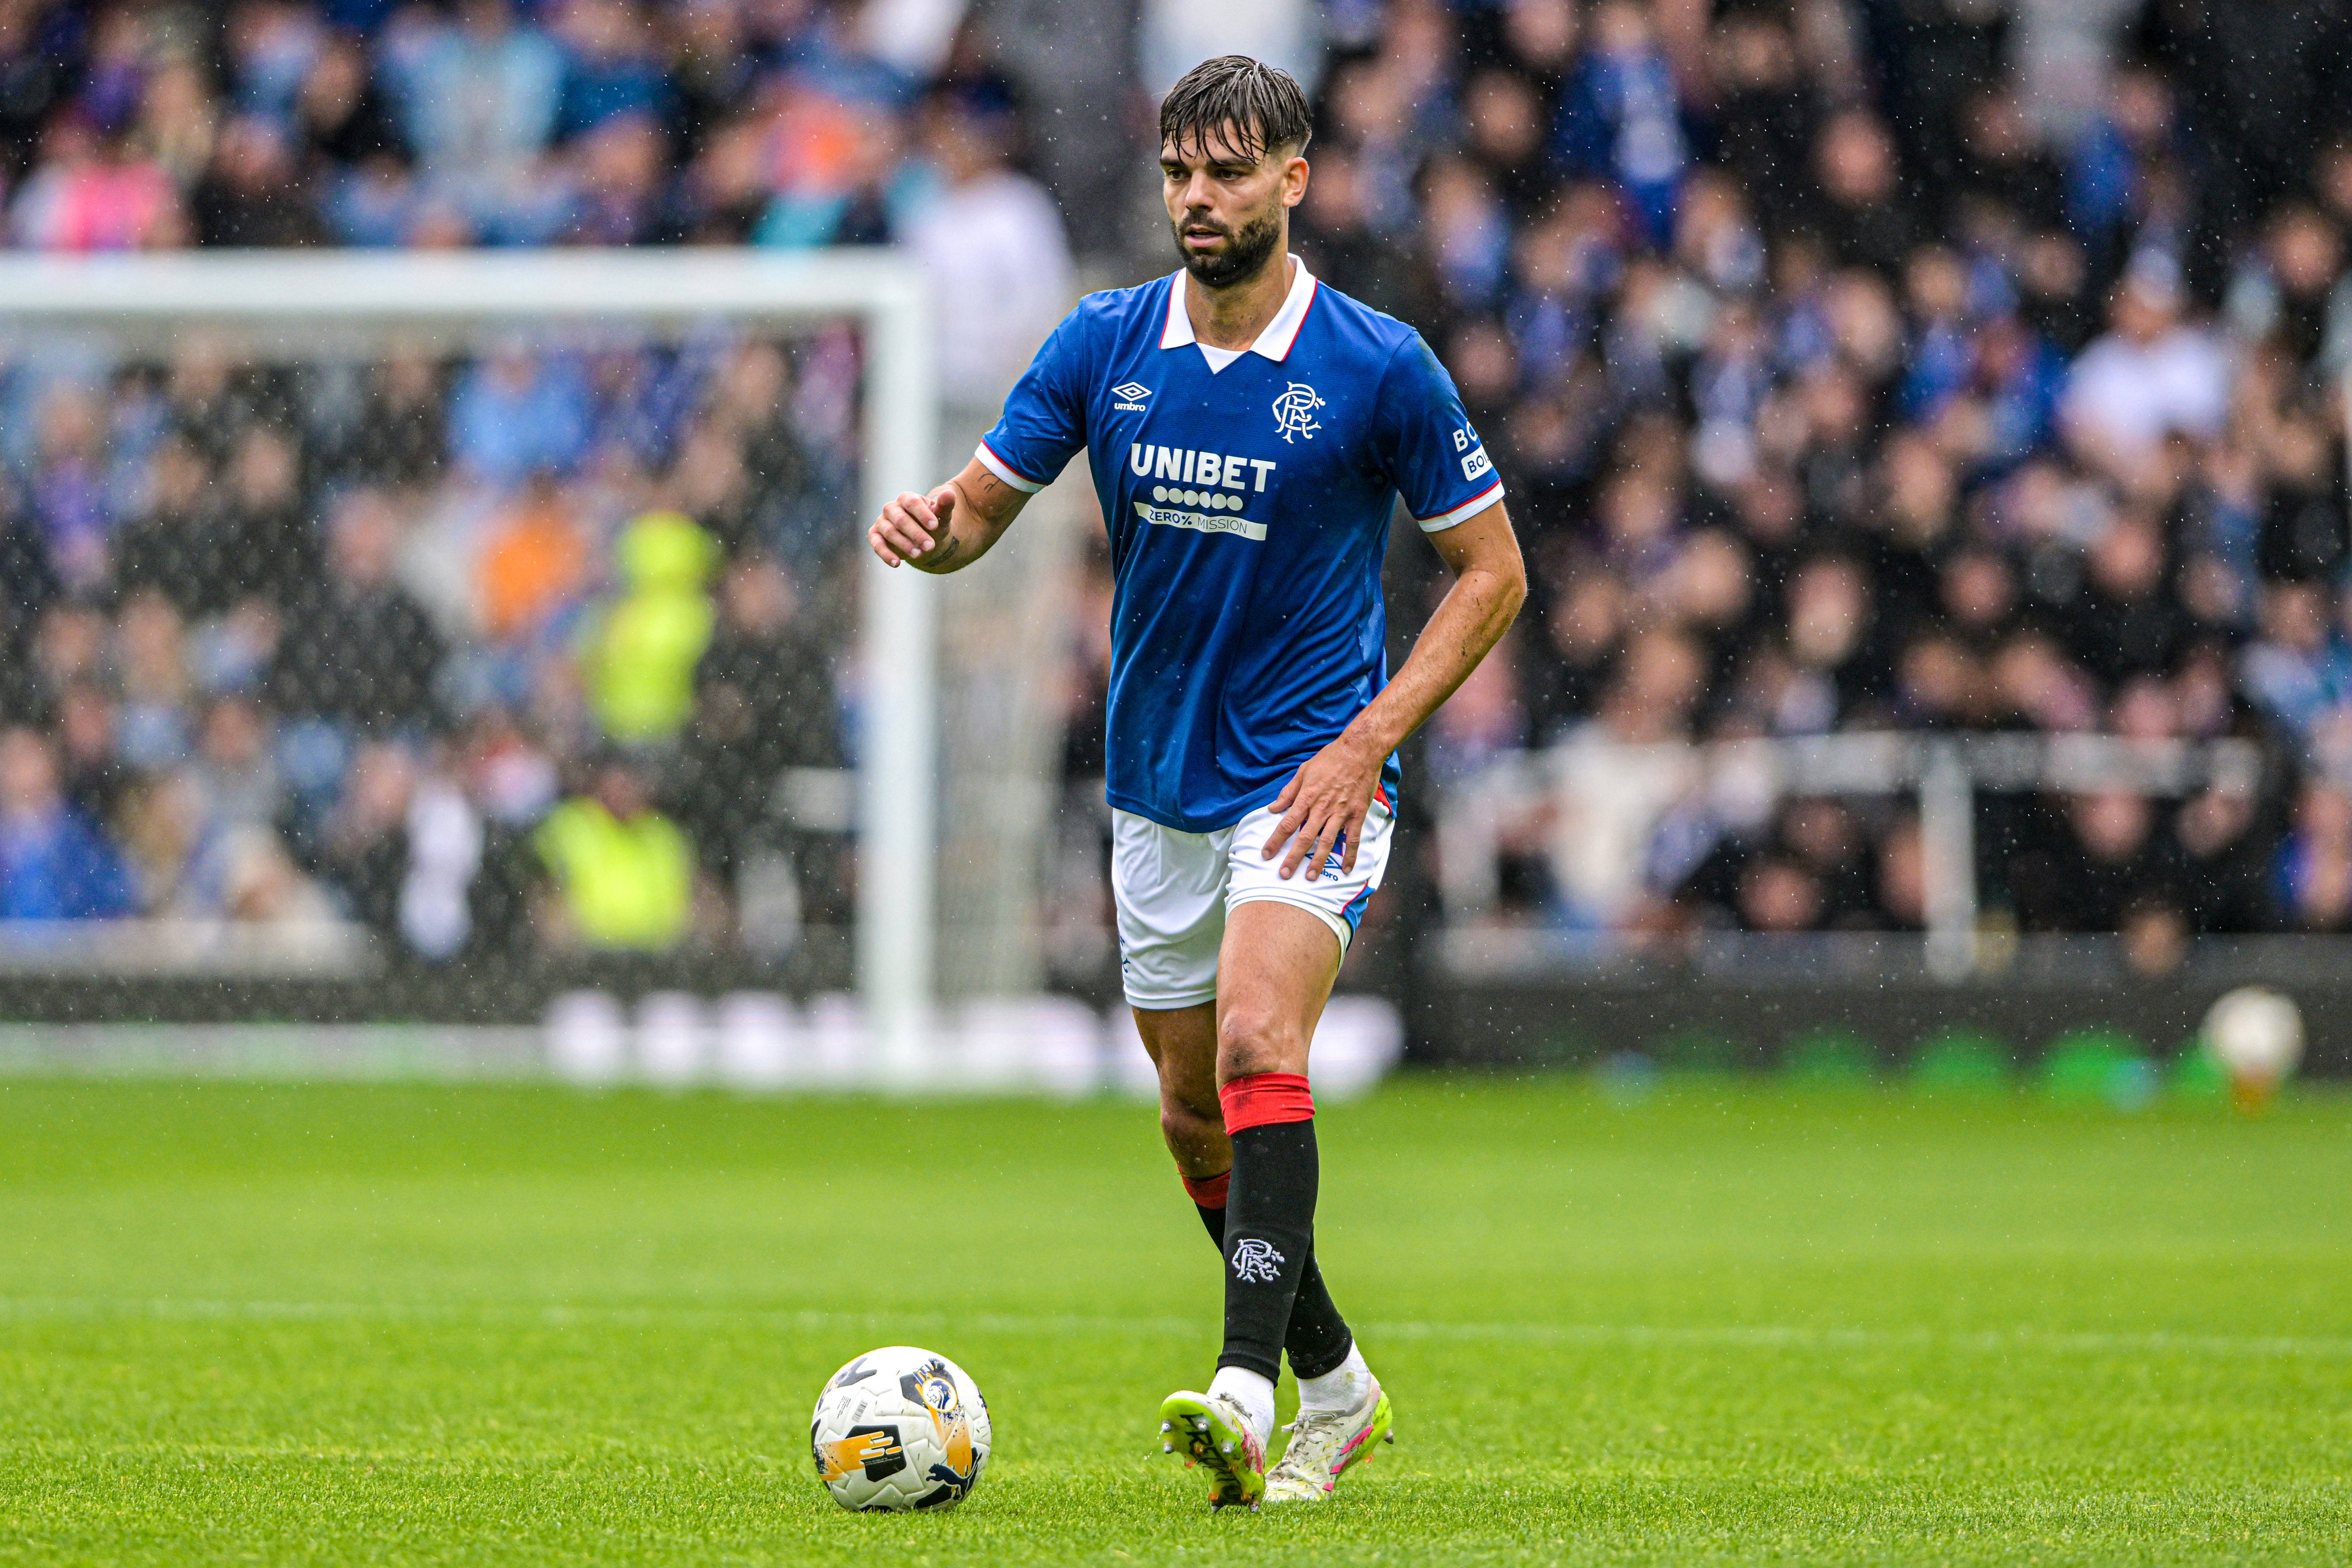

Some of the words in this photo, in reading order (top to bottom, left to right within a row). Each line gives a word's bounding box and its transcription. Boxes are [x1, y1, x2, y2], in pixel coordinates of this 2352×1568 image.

[1114, 402, 1146, 411] umbro
[1131, 443, 1276, 492] UNIBET
[1149, 508, 1193, 526] ZERO%
[1197, 516, 1247, 534] MISSION
[1321, 869, 1339, 881] bro
